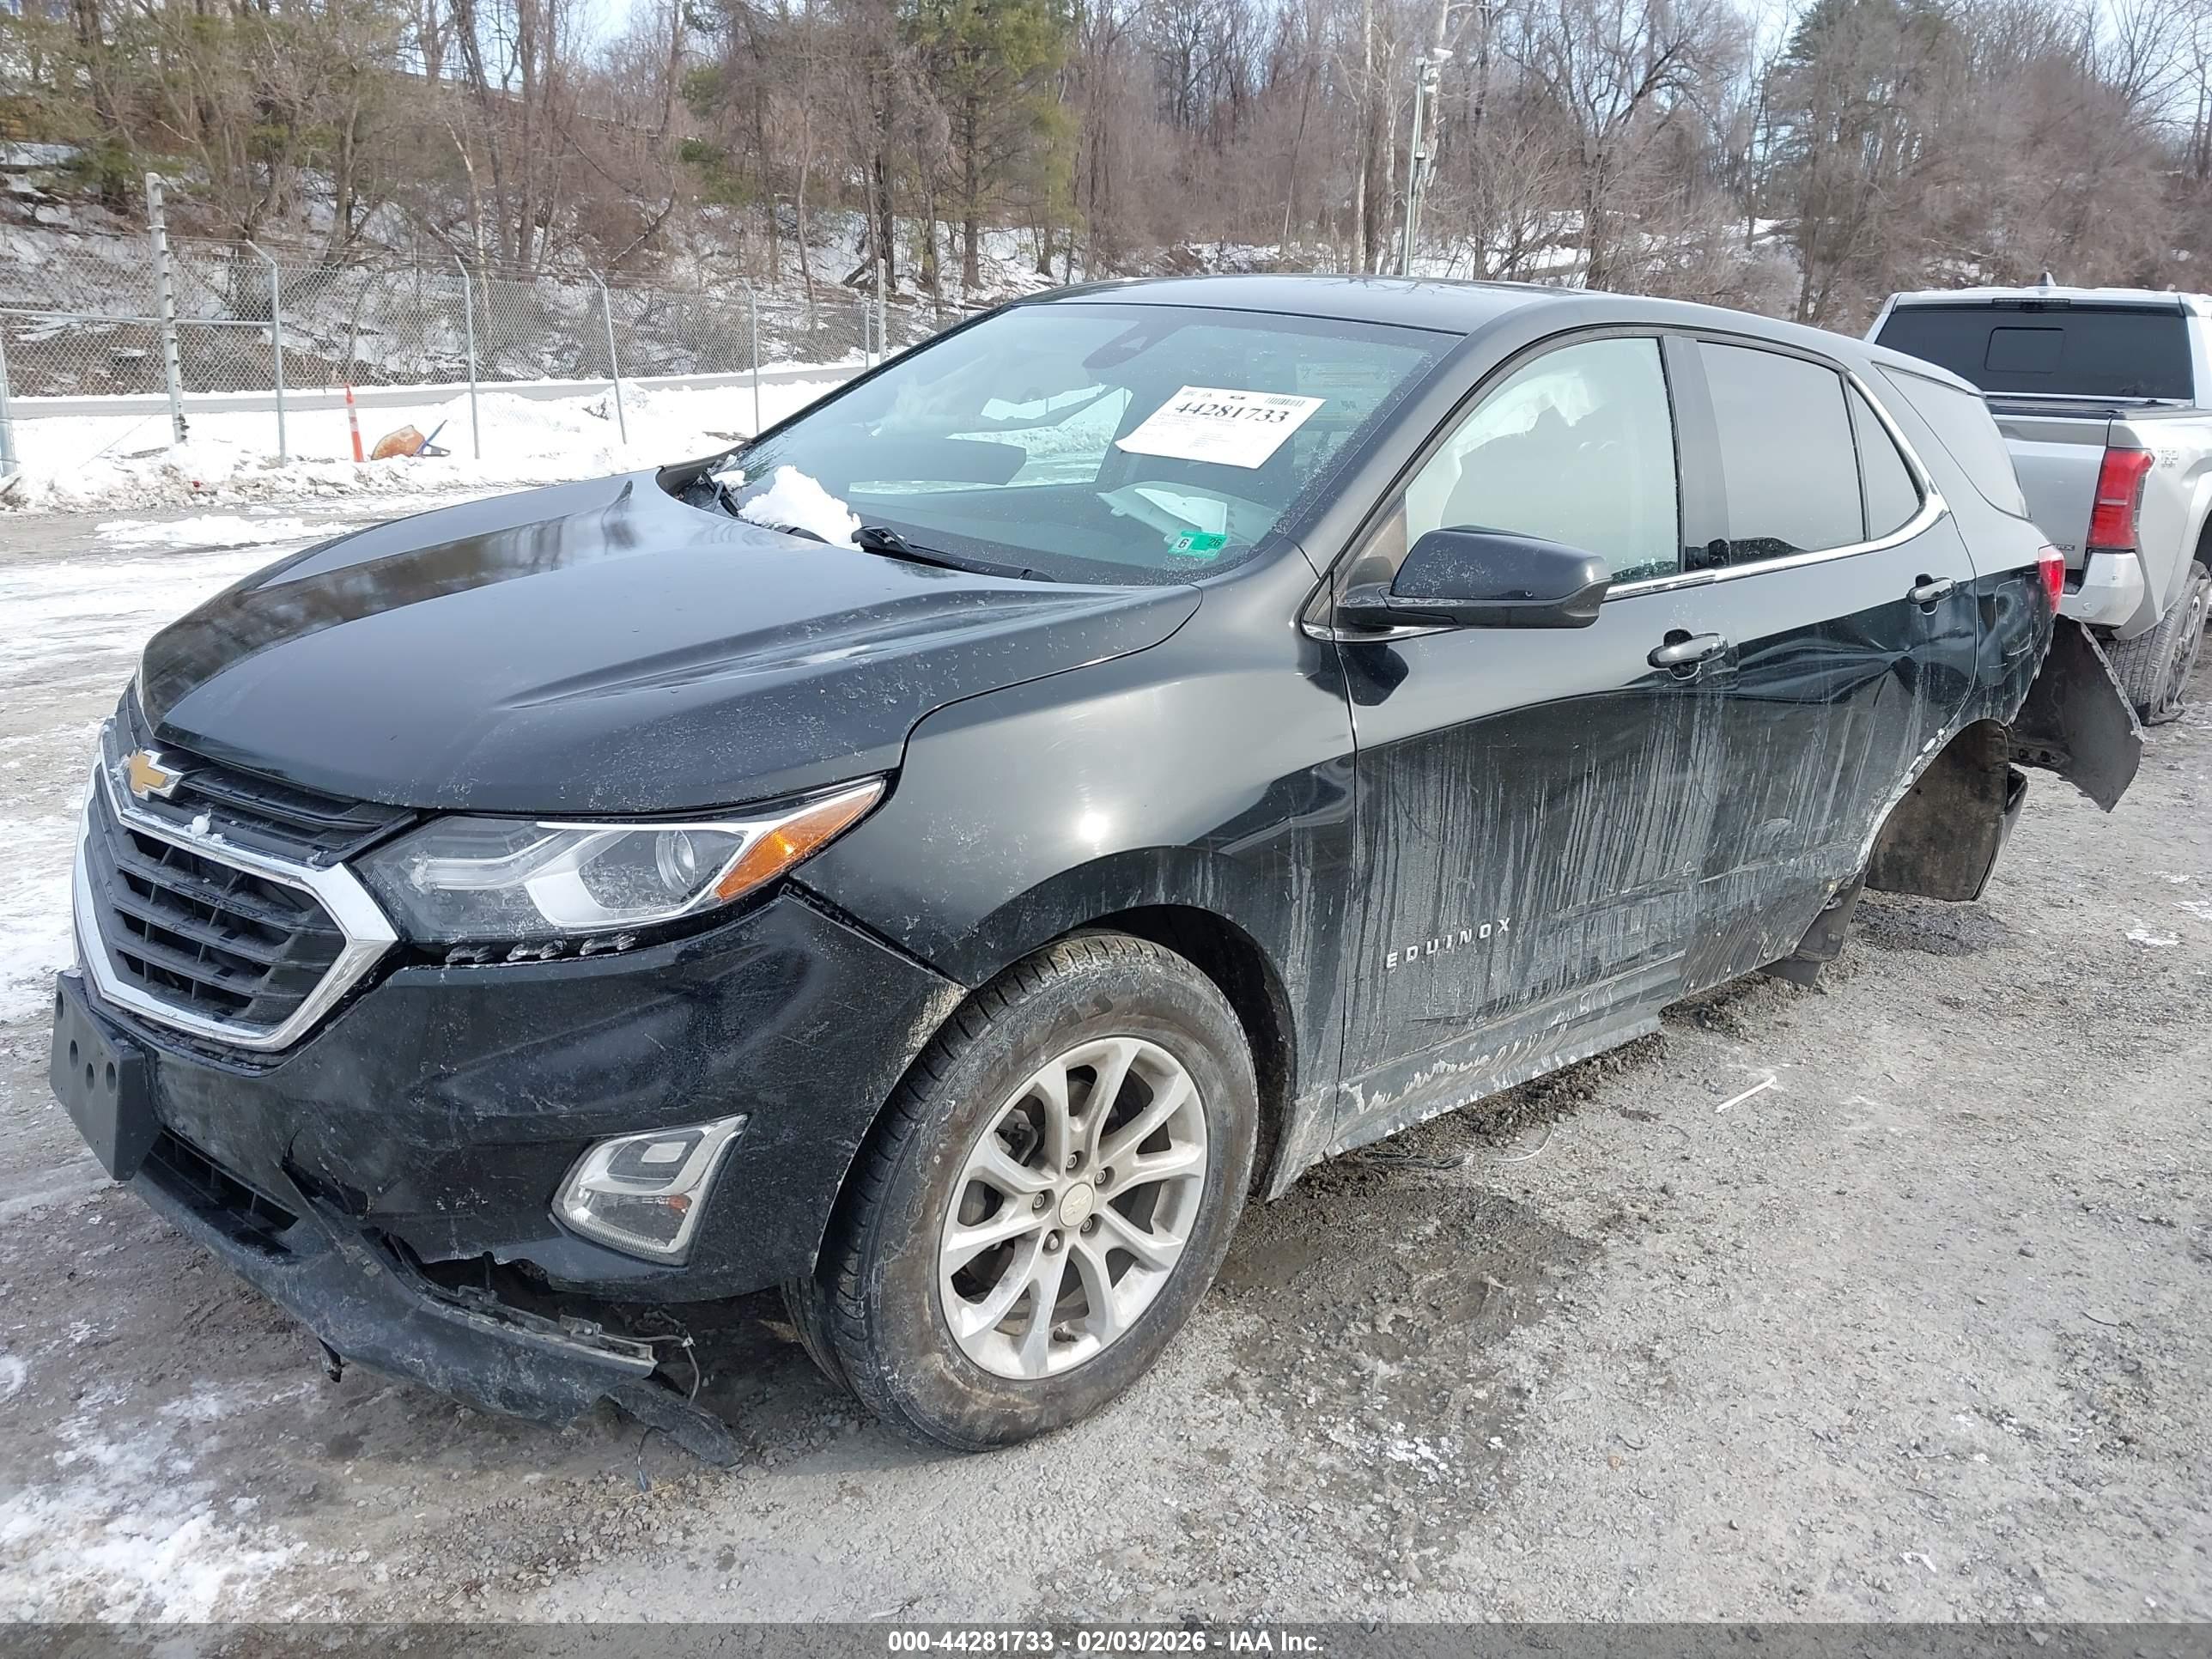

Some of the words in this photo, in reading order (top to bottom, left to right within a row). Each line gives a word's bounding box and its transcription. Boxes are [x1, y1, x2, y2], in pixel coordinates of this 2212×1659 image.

[1175, 401, 1290, 423] 44281733
[1177, 538, 1189, 549] 6
[1207, 538, 1223, 548] 26
[1385, 916, 1511, 969] EQUINOX
